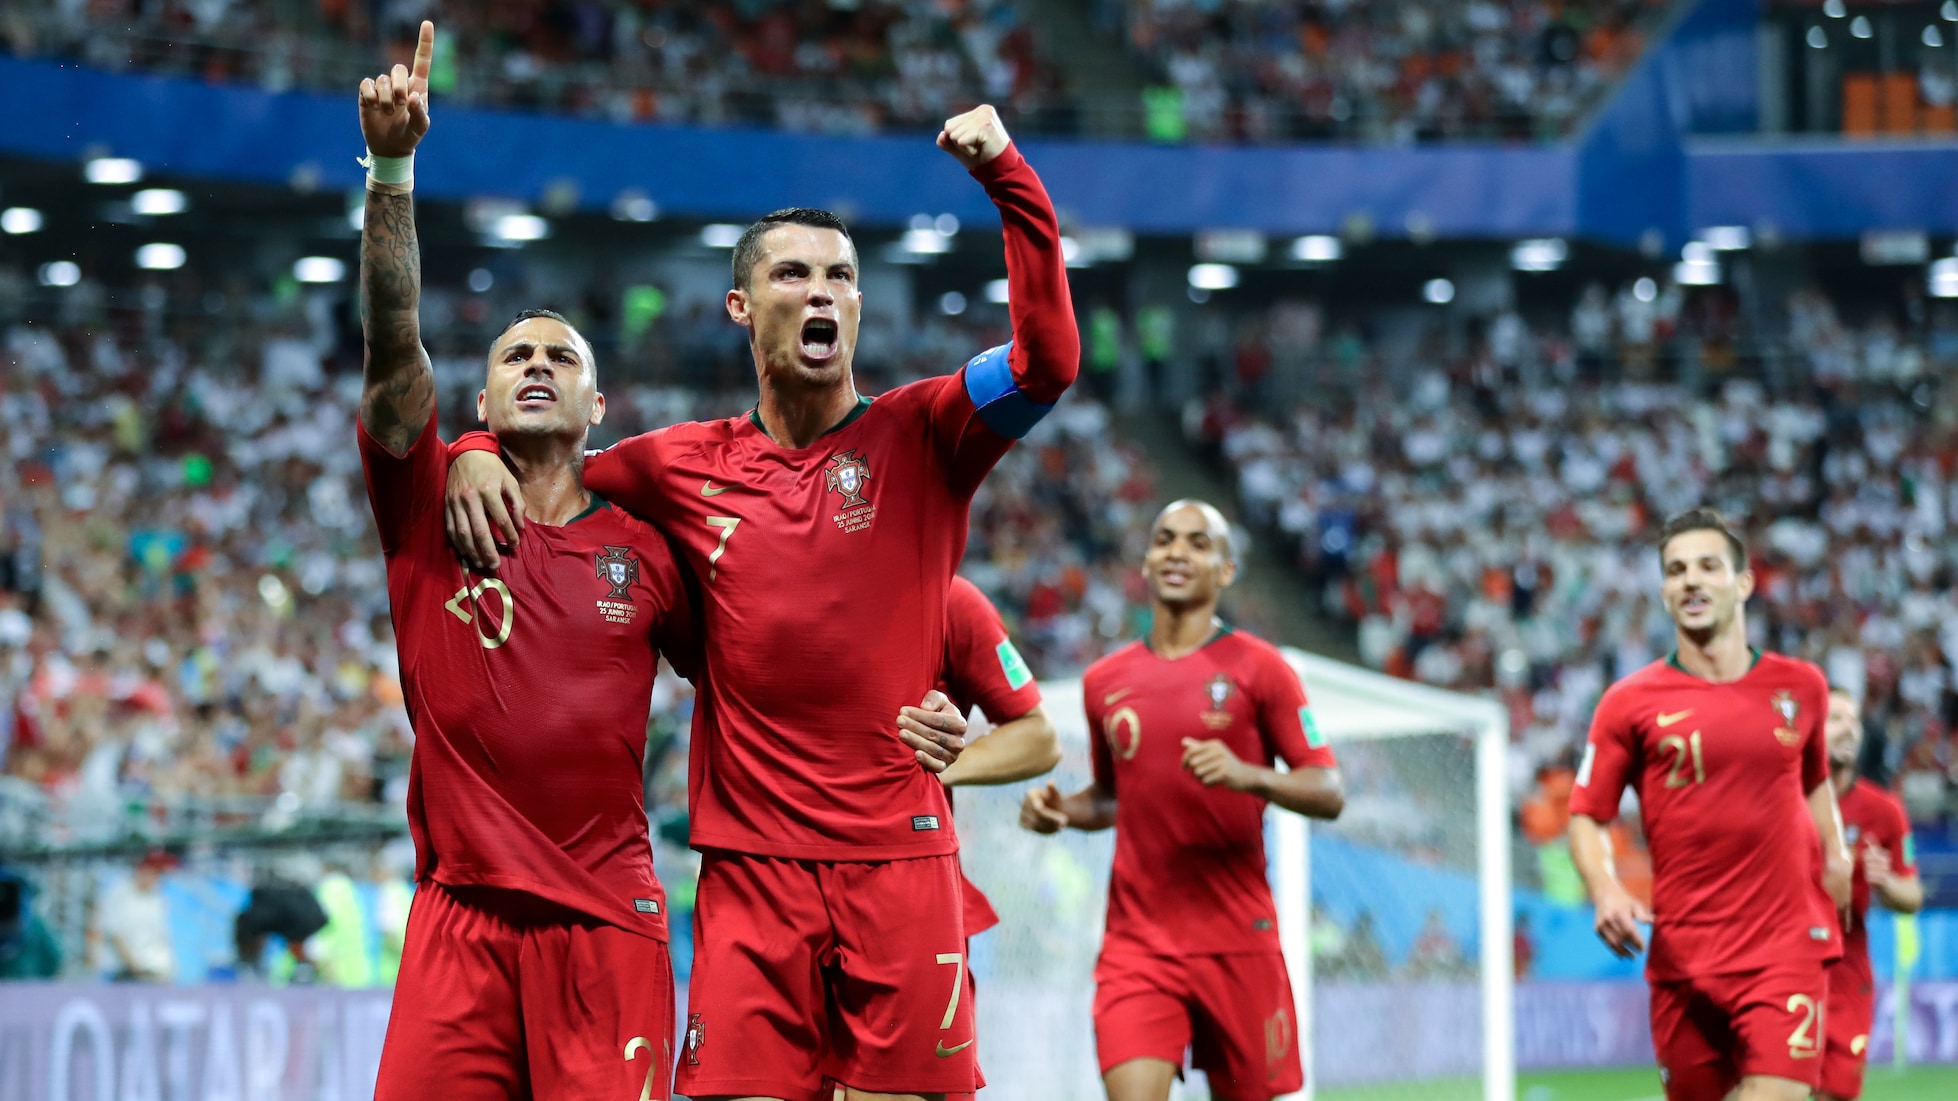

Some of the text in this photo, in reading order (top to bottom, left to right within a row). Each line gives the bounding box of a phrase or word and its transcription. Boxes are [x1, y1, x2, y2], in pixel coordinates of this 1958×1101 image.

[706, 515, 742, 583] 7
[844, 521, 871, 533] SARANSK
[605, 615, 631, 624] SARANSK
[1658, 728, 1705, 789] 21
[935, 952, 963, 1030] 7
[1264, 1008, 1292, 1067] 10
[1786, 992, 1823, 1052] 21
[624, 1036, 670, 1101] 2
